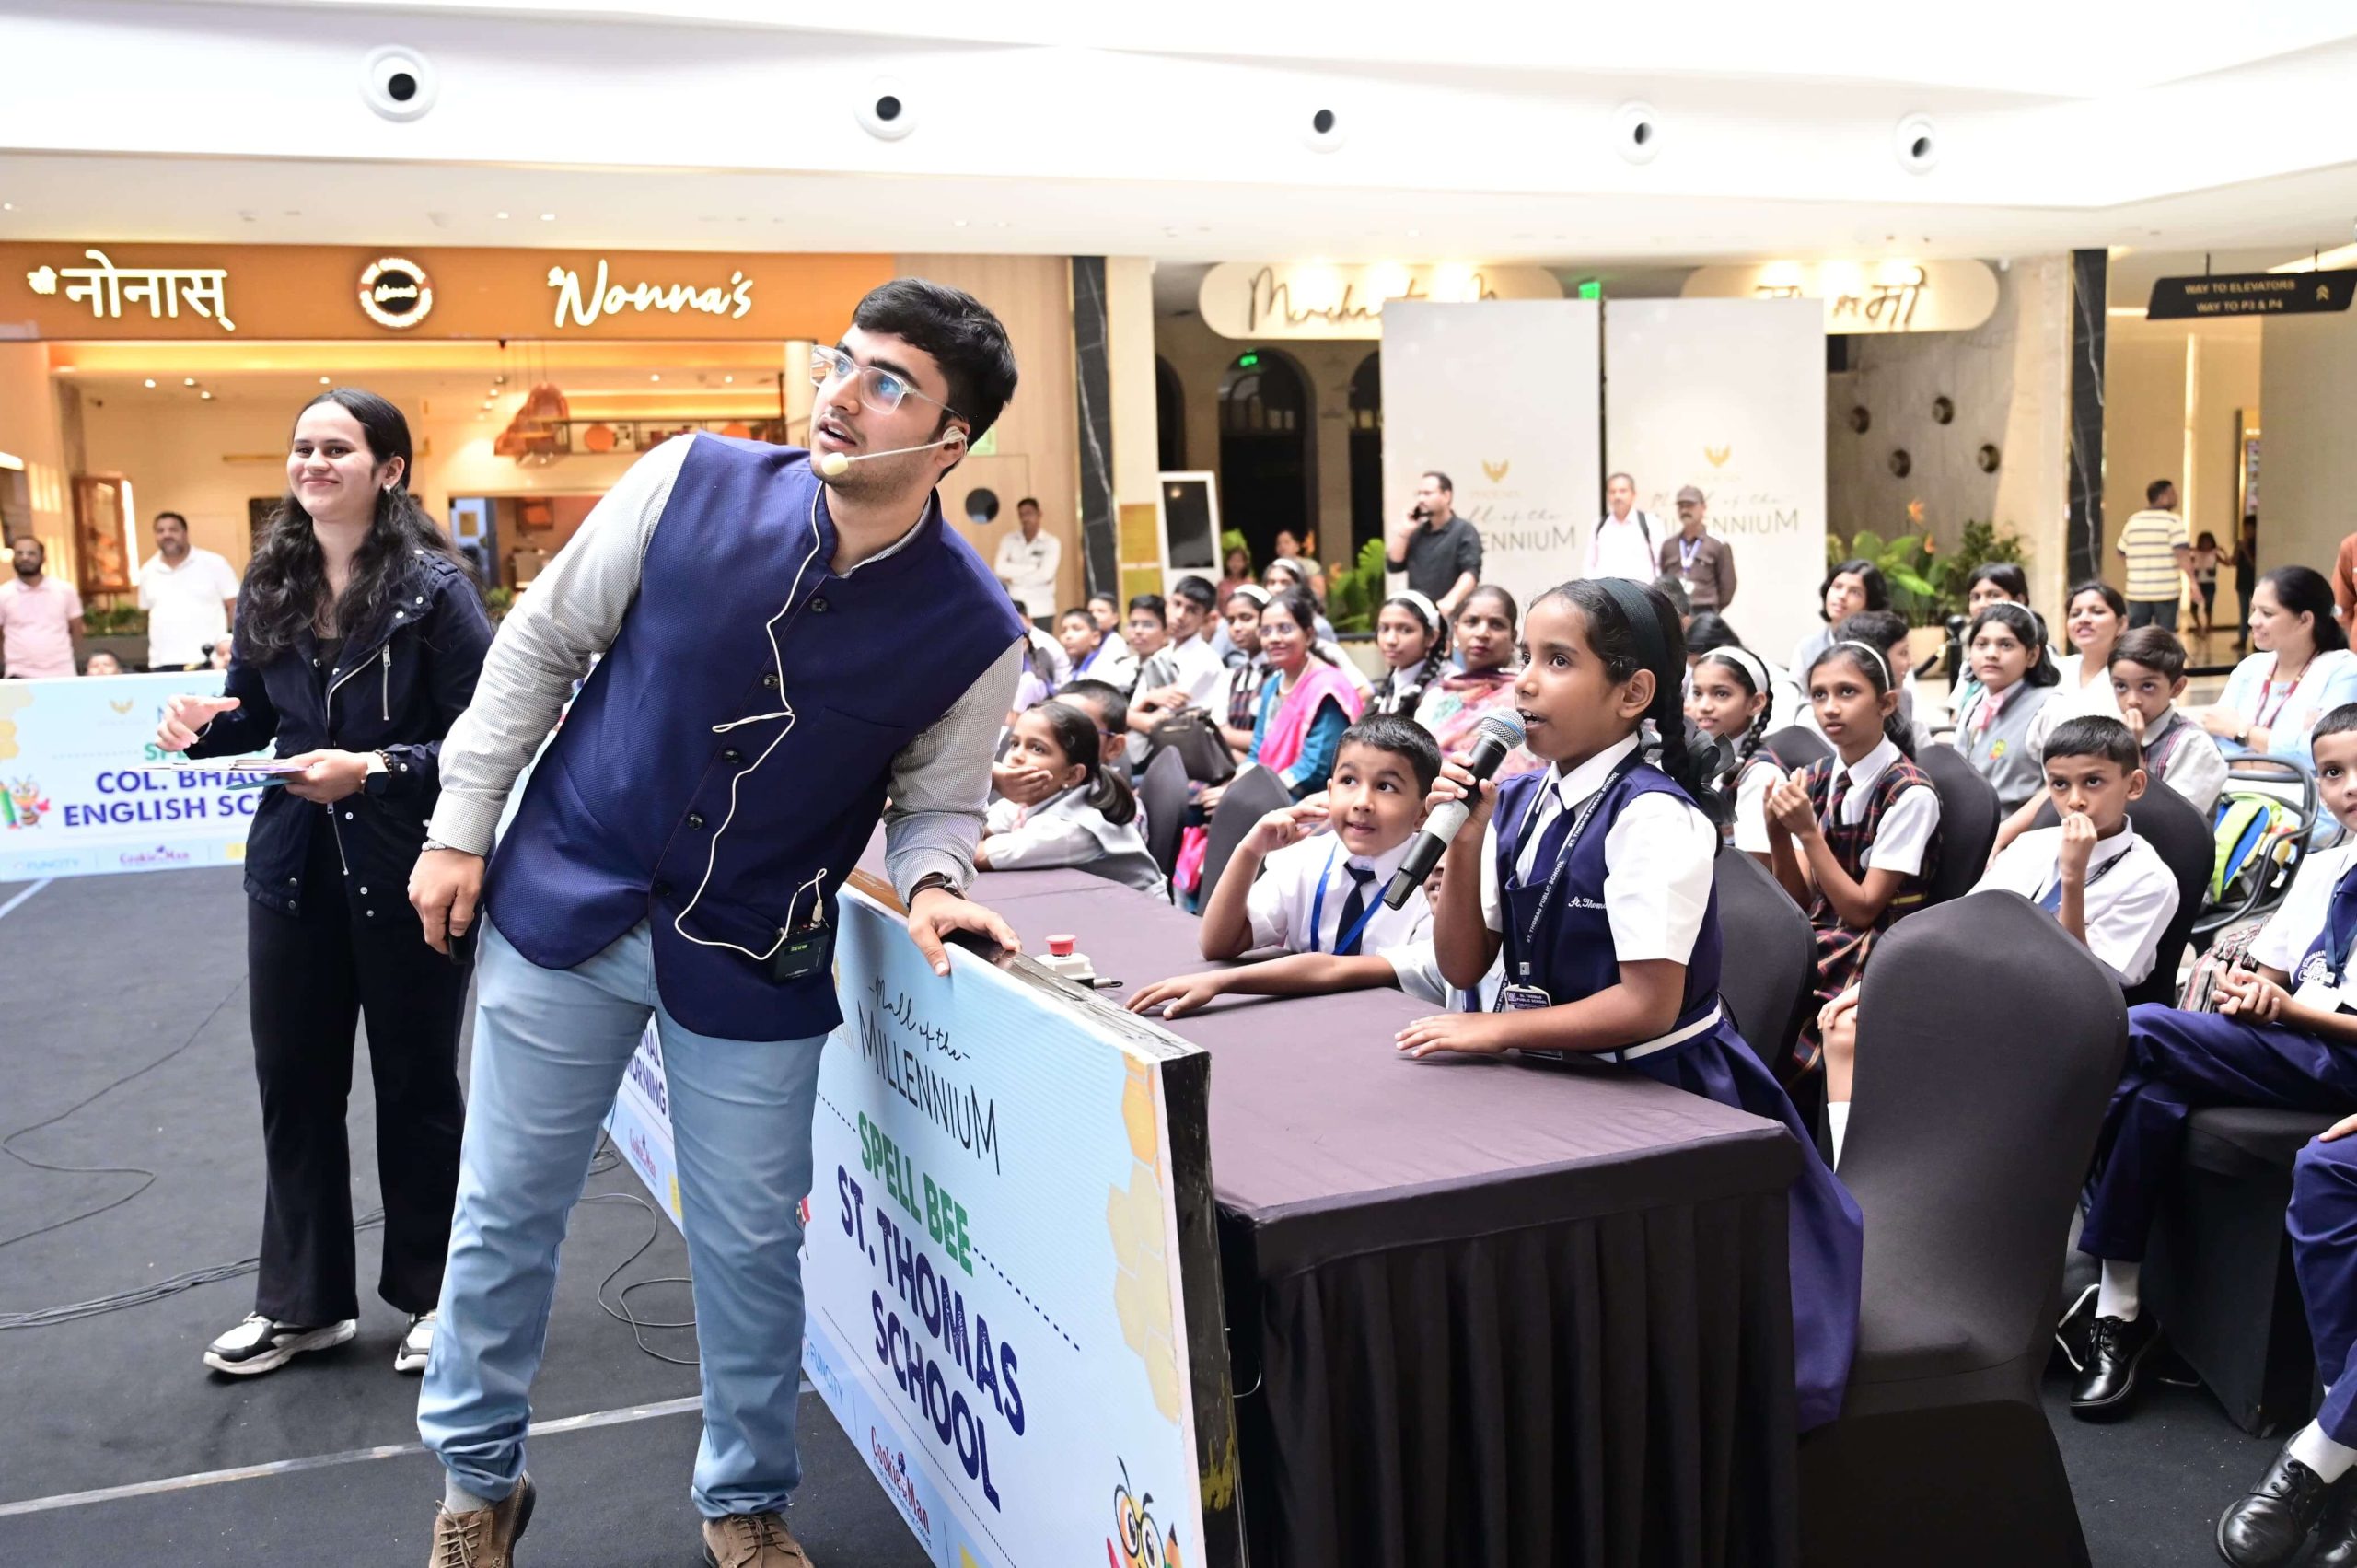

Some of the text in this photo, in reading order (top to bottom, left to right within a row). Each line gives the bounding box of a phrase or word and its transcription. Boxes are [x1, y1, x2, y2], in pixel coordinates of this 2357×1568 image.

[60, 249, 236, 331] नोनास्
[553, 258, 754, 328] Nonna's
[2185, 279, 2295, 295] WAY TO ELEVATORS
[2196, 302, 2221, 312] WAY
[2224, 301, 2238, 311] TO
[64, 796, 206, 827] ENGLISH
[96, 770, 168, 795] COL.
[1573, 813, 1590, 838] THOMAS
[1601, 772, 1620, 793] SCHOOL
[1529, 907, 1542, 933] THOMAS
[1538, 884, 1552, 908] PUBLIC
[1548, 860, 1565, 886] SCHOOL
[875, 975, 962, 1062] Mall of the
[857, 999, 1001, 1176] MILLENNIUM
[858, 1110, 974, 1278] SPELL BEE
[837, 1164, 1026, 1437] ST. THOMAS
[871, 1289, 1001, 1514] SCHOOL
[870, 1425, 931, 1536] Cookie Man
